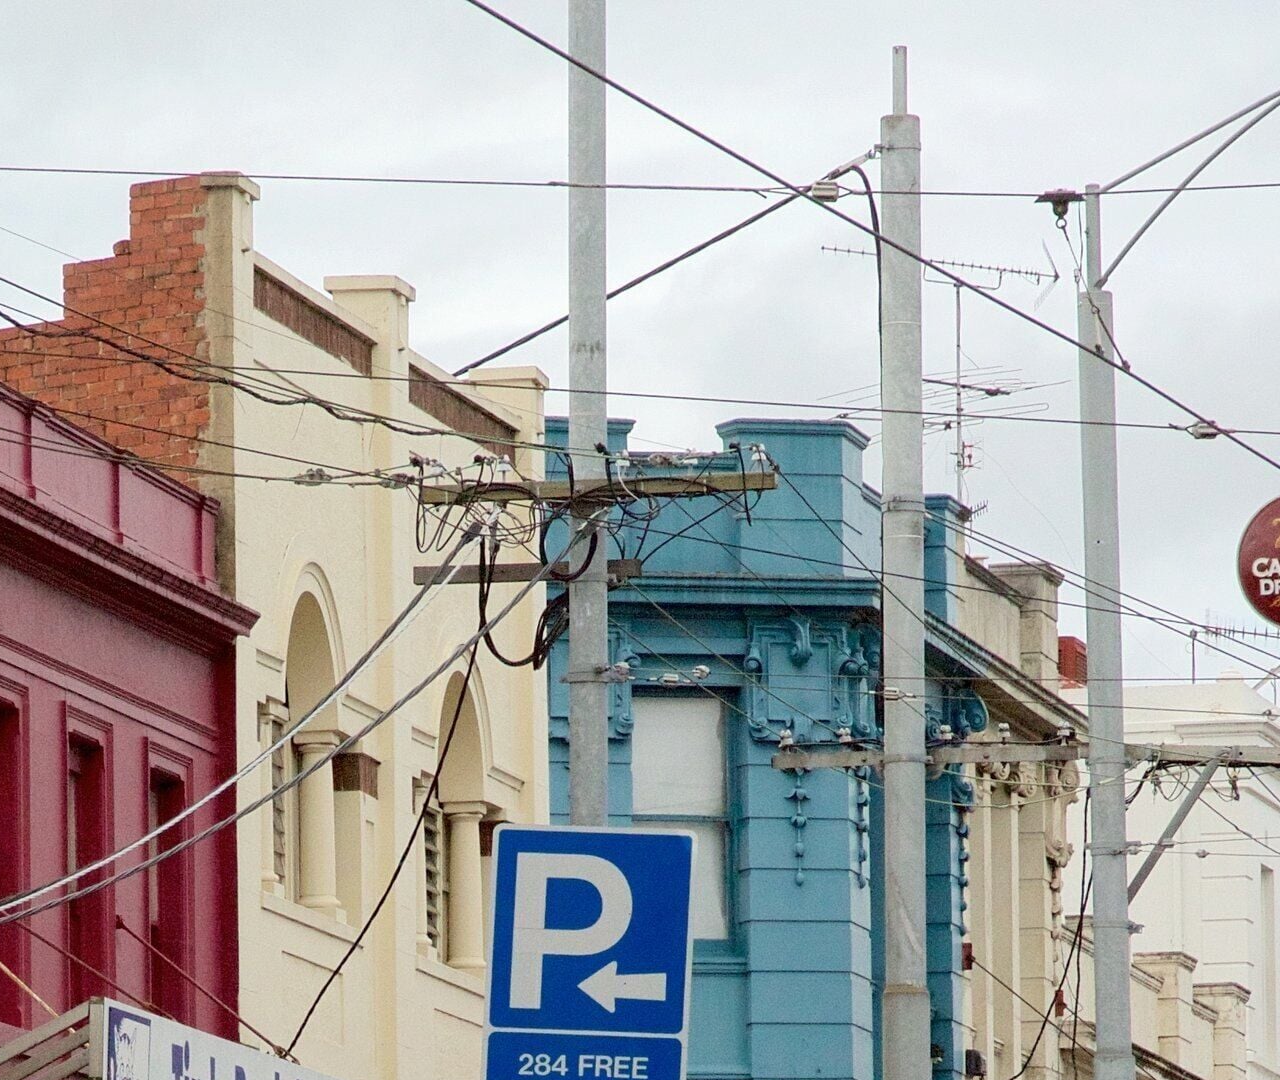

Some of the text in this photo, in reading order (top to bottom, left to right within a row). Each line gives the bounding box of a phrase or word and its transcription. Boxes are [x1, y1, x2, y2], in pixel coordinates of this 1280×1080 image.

[509, 851, 633, 1009] P
[518, 1053, 649, 1079] 284 FREE
